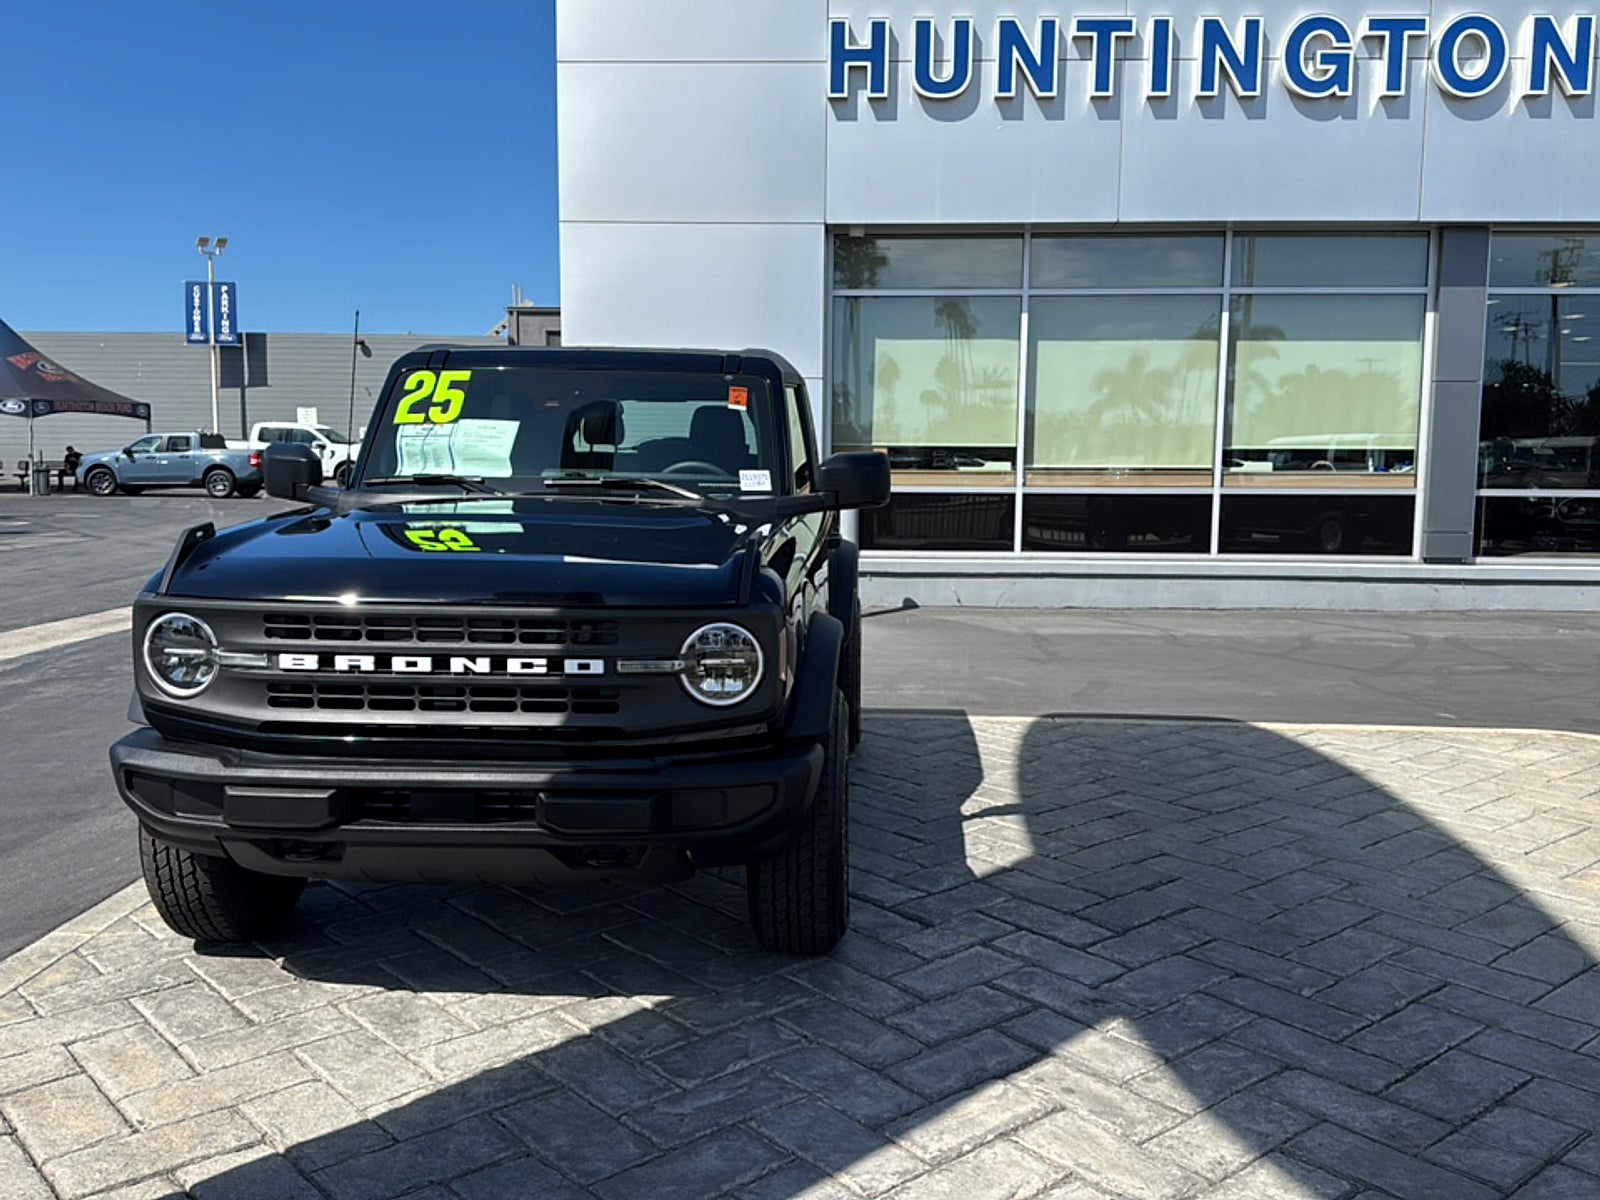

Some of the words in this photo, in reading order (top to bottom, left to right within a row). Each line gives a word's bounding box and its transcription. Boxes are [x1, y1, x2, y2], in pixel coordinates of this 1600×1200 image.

[827, 13, 1596, 99] HUNTINGTON
[193, 285, 201, 333] CUSTOMER
[221, 285, 230, 333] PARKING
[393, 370, 472, 424] 25
[278, 653, 605, 675] BRONCO
